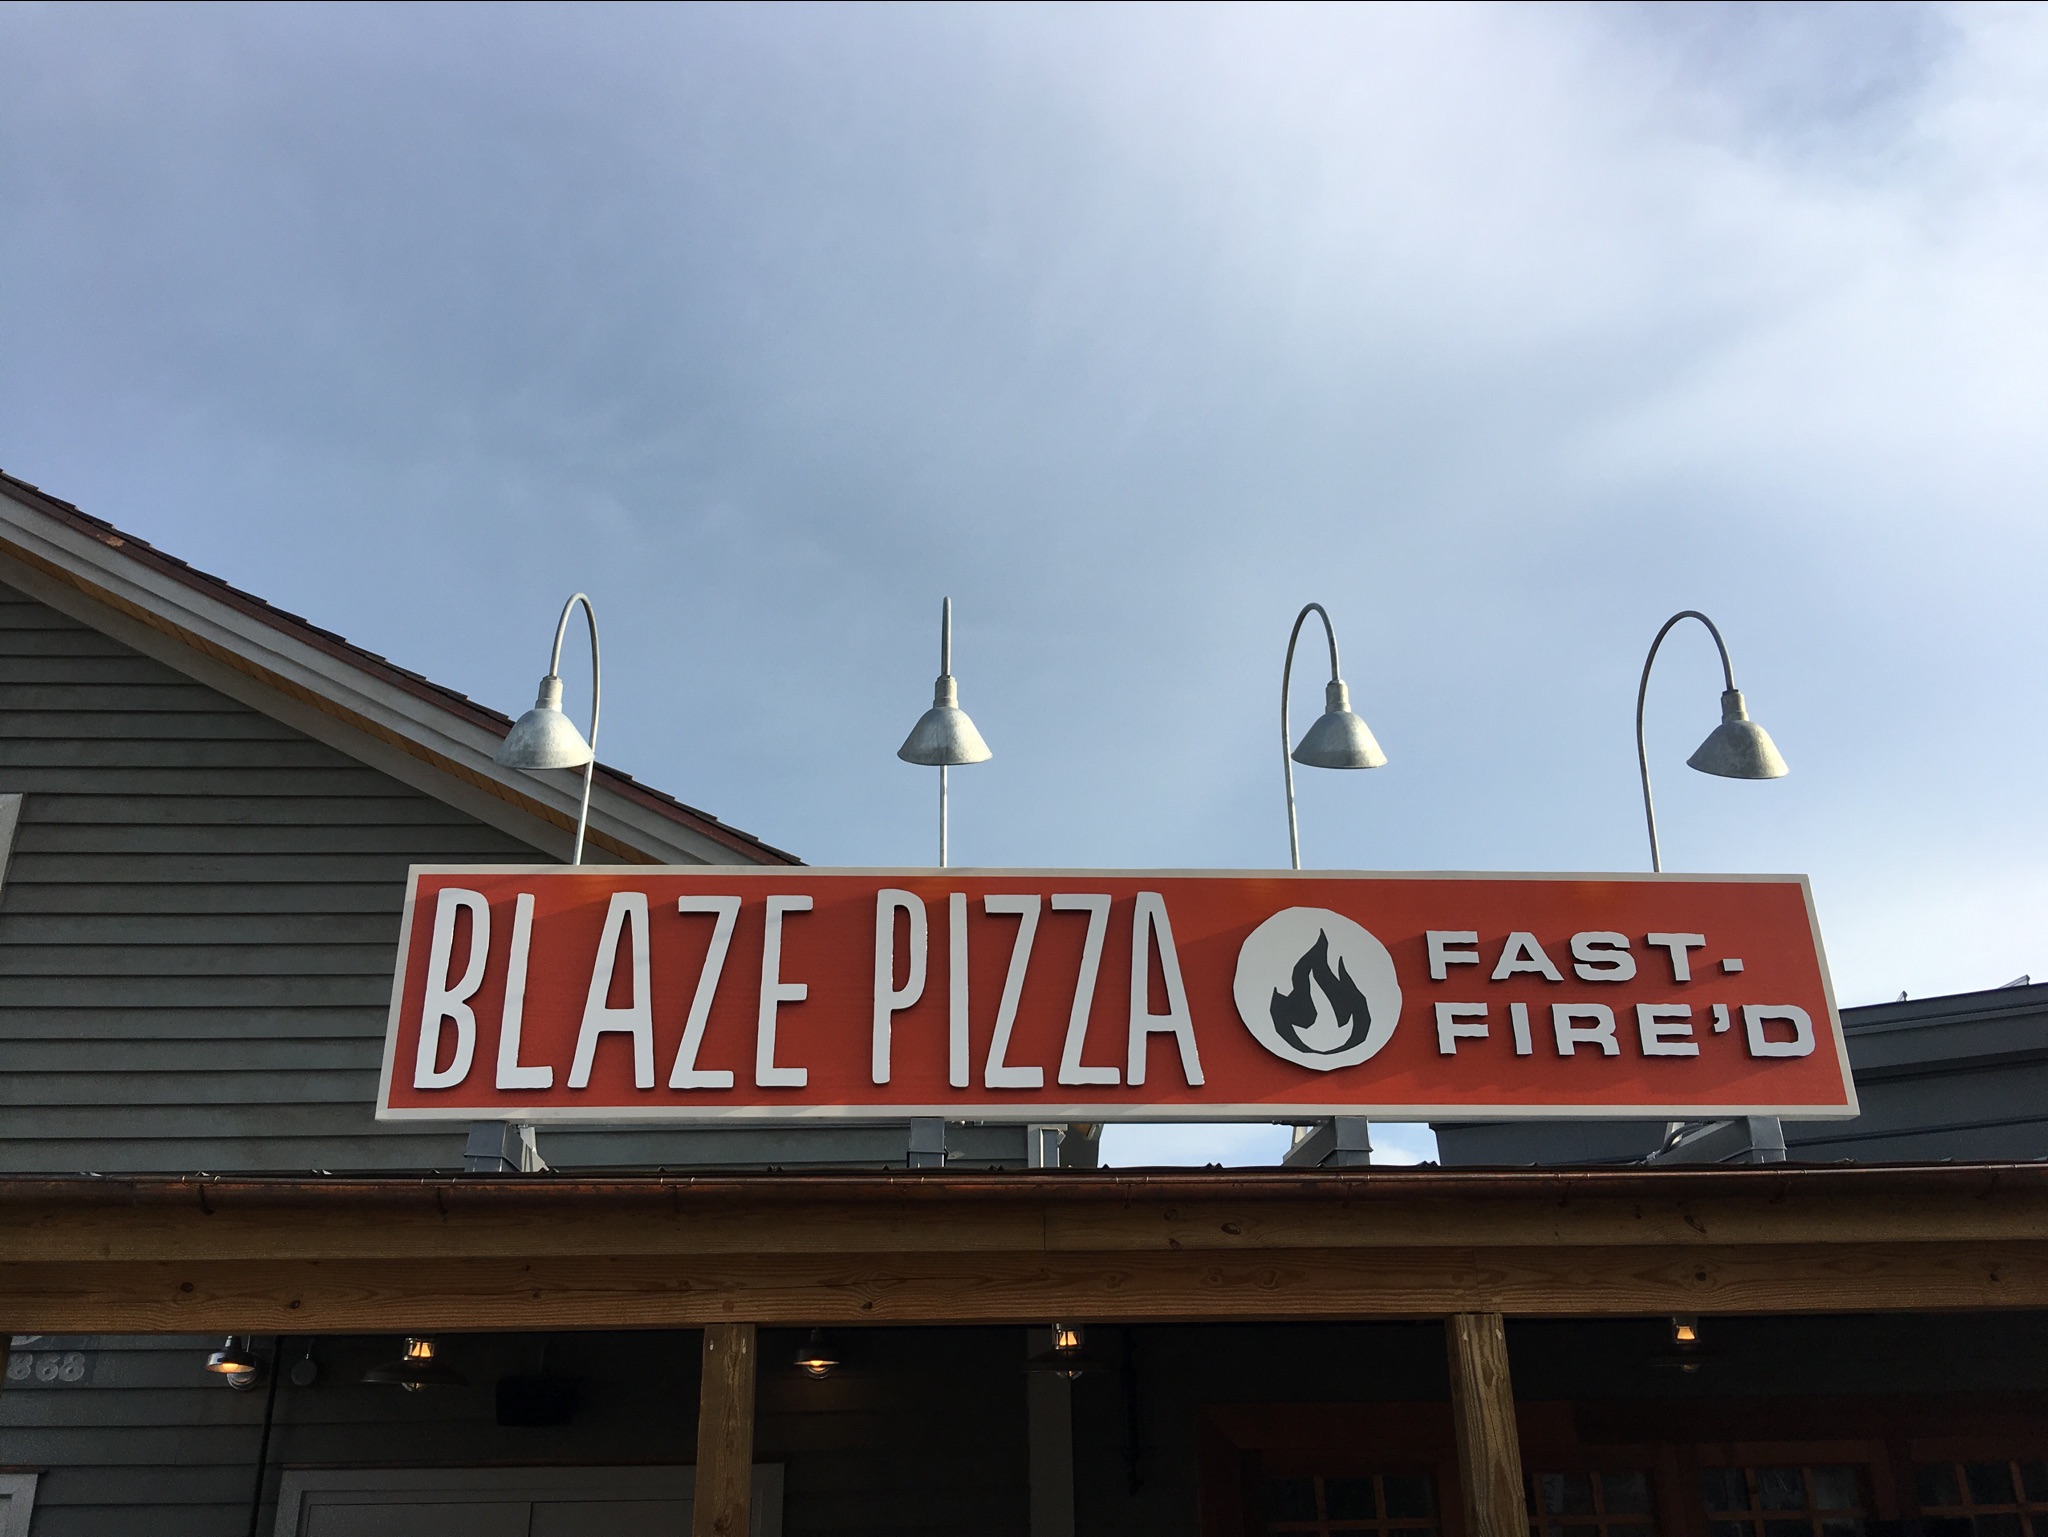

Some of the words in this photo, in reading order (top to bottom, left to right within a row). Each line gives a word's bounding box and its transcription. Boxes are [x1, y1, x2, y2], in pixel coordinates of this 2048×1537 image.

[413, 888, 814, 1090] BLAZE
[871, 888, 1206, 1088] PIZZA
[1435, 1002, 1817, 1057] FIRE'D
